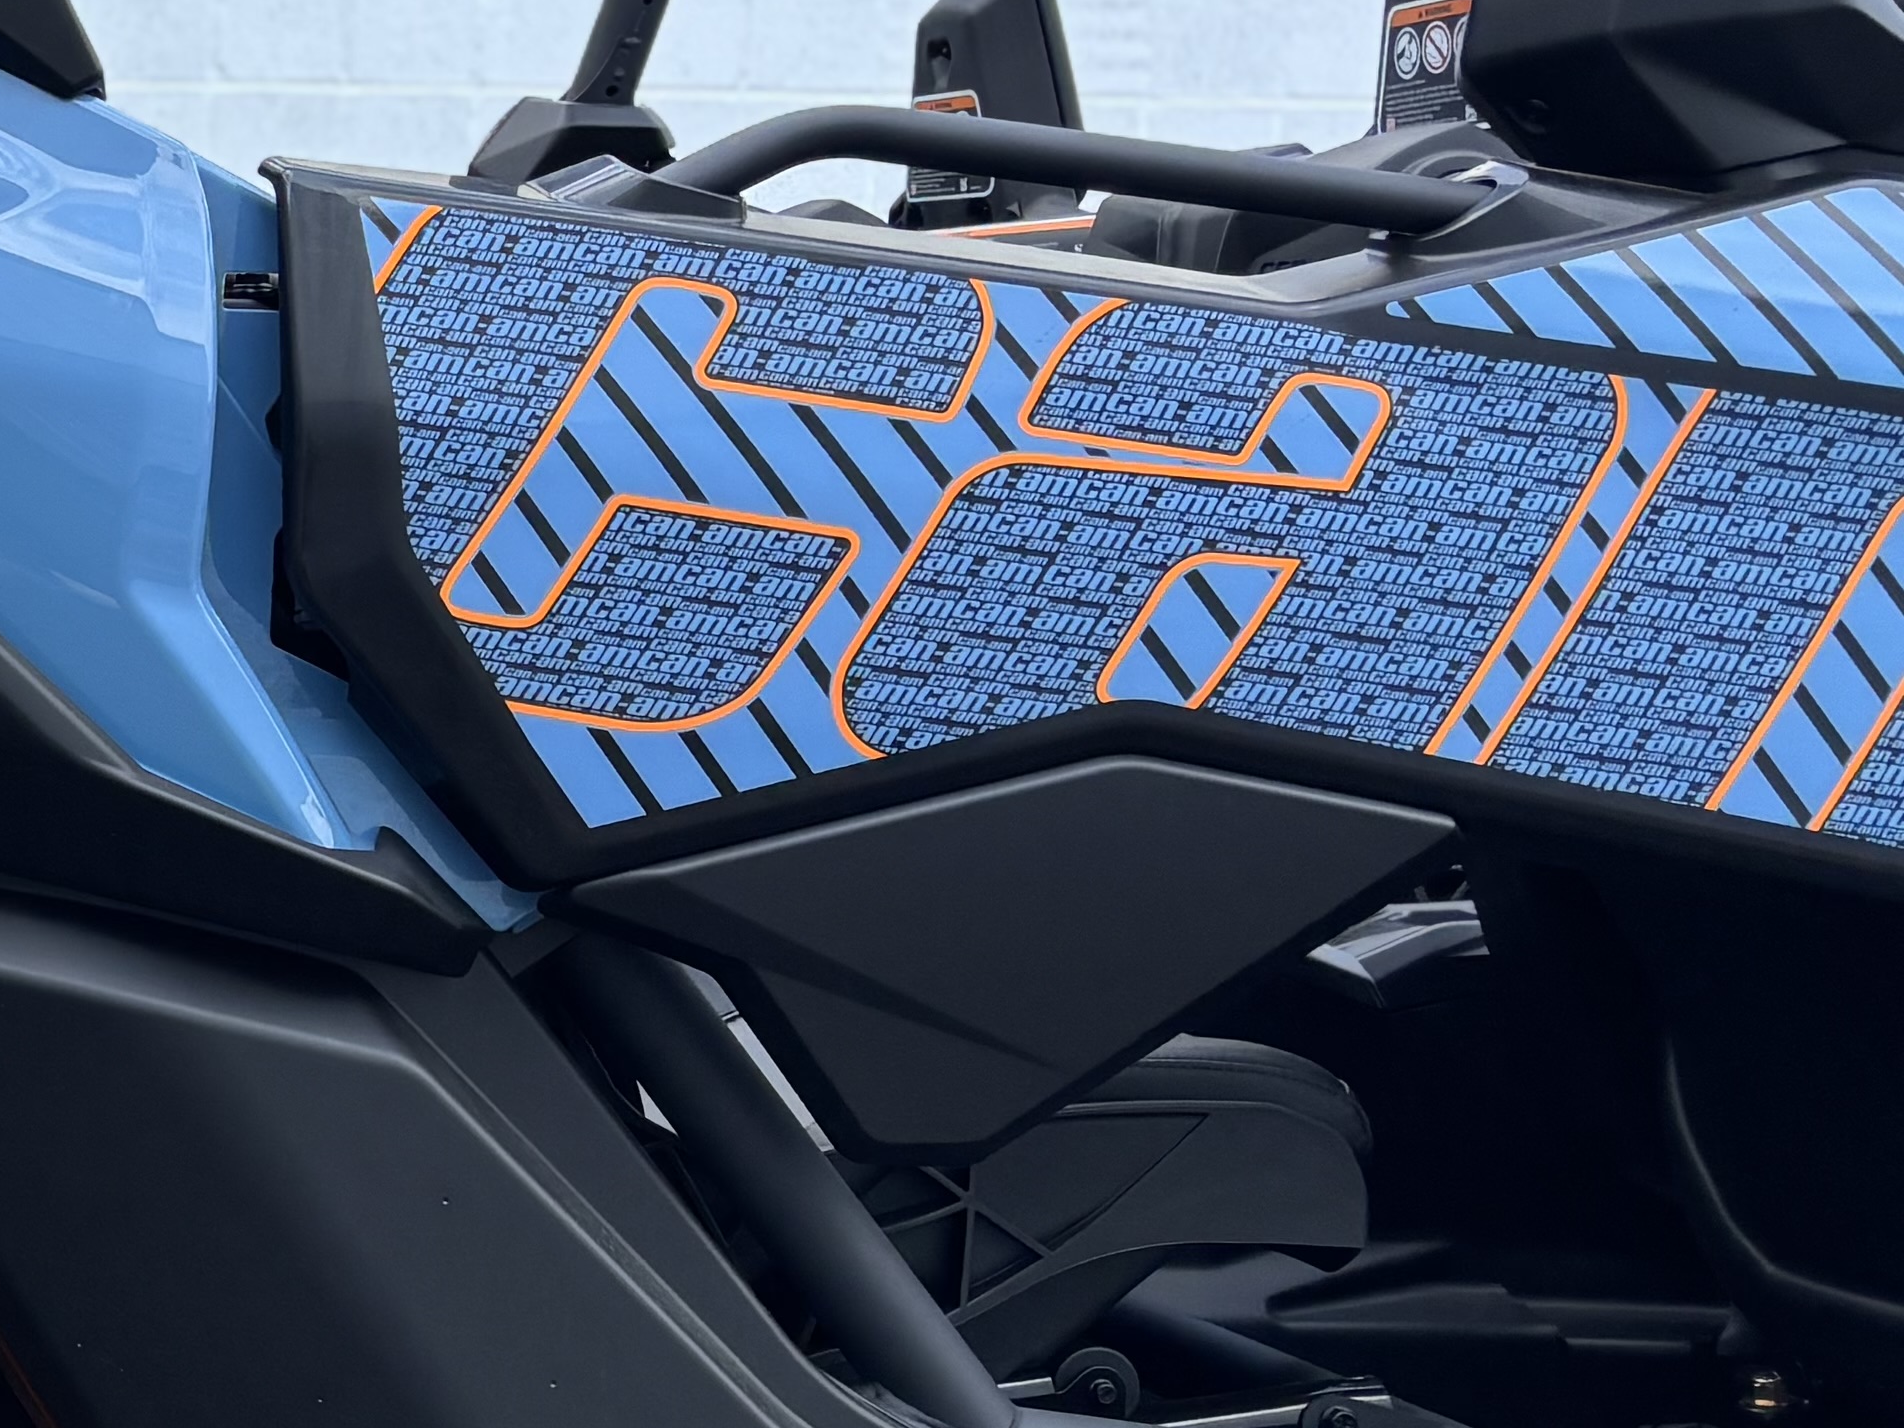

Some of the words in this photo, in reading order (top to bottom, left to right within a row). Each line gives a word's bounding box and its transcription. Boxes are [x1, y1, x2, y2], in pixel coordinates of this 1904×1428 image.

[445, 216, 526, 237] can-am
[585, 232, 665, 253] can-am
[434, 226, 574, 261] can-am
[574, 241, 714, 278] can-am
[715, 258, 855, 295] can-am
[727, 248, 807, 269] can-am
[866, 265, 946, 286] can-am
[503, 263, 583, 284] can-am
[419, 295, 500, 316] can-am
[783, 297, 863, 318] can-am
[403, 324, 480, 345] can-am
[408, 305, 548, 342] can-am
[771, 307, 911, 345] can-am
[1134, 309, 1274, 346] can-am
[1272, 327, 1412, 364] can-am
[475, 345, 556, 366] can-am
[837, 347, 918, 368] can-am
[1201, 349, 1282, 370] can-am
[392, 377, 472, 398] can-am
[820, 377, 897, 398] can-am
[1119, 381, 1199, 402] can-am
[1481, 382, 1565, 404] can-am
[1107, 392, 1247, 429] can-am
[1471, 393, 1611, 430] can-am
[1034, 415, 1114, 436] can-am
[1101, 412, 1178, 432] can-am
[1398, 416, 1478, 438] can-am
[1763, 418, 1843, 439] can-am
[447, 429, 527, 451] can-am
[1386, 427, 1526, 465] can-am
[1749, 429, 1889, 466] can-am
[1677, 451, 1757, 473] can-am
[1453, 467, 1533, 489] can-am
[1664, 462, 1804, 499] can-am
[1815, 469, 1892, 490] can-am
[1077, 478, 1217, 515] can-am
[1217, 495, 1357, 533] can-am
[1356, 513, 1496, 550] can-am
[1229, 484, 1310, 506] can-am
[1369, 502, 1449, 523] can-am
[1729, 503, 1810, 524] can-am
[624, 512, 764, 549] can-am
[988, 512, 1128, 550] can-am
[1211, 515, 1288, 536] can-am
[1719, 514, 1853, 550] can-am
[617, 531, 694, 552] can-am
[982, 531, 1059, 553] can-am
[1001, 501, 1082, 522] can-am
[1143, 518, 1224, 540] can-am
[1284, 536, 1364, 558] can-am
[1423, 553, 1503, 575] can-am
[1351, 533, 1428, 553] can-am
[1646, 536, 1726, 558] can-am
[688, 552, 768, 573] can-am
[755, 549, 832, 570] can-am
[1057, 553, 1138, 574] can-am
[1636, 549, 1770, 585] can-am
[674, 564, 814, 601] can-am
[601, 587, 681, 608] can-am
[967, 587, 1047, 609] can-am
[1337, 588, 1417, 609] can-am
[1700, 590, 1777, 611] can-am
[581, 617, 658, 638] can-am
[588, 598, 728, 635] can-am
[954, 599, 1094, 636] can-am
[1324, 599, 1464, 636] can-am
[878, 622, 958, 643] can-am
[1018, 640, 1098, 662] can-am
[1613, 624, 1694, 645] can-am
[500, 630, 640, 667] can-am
[651, 638, 732, 660] can-am
[865, 633, 1005, 670] can-am
[1389, 640, 1470, 662] can-am
[1600, 635, 1740, 672] can-am
[562, 673, 642, 694] can-am
[929, 674, 1010, 695] can-am
[1302, 674, 1382, 696] can-am
[1370, 671, 1447, 692] can-am
[1668, 676, 1745, 697] can-am
[549, 684, 689, 721] can-am
[1288, 685, 1428, 723] can-am
[1579, 710, 1660, 731] can-am
[1566, 720, 1706, 757] can-am
[1631, 762, 1711, 783] can-am
